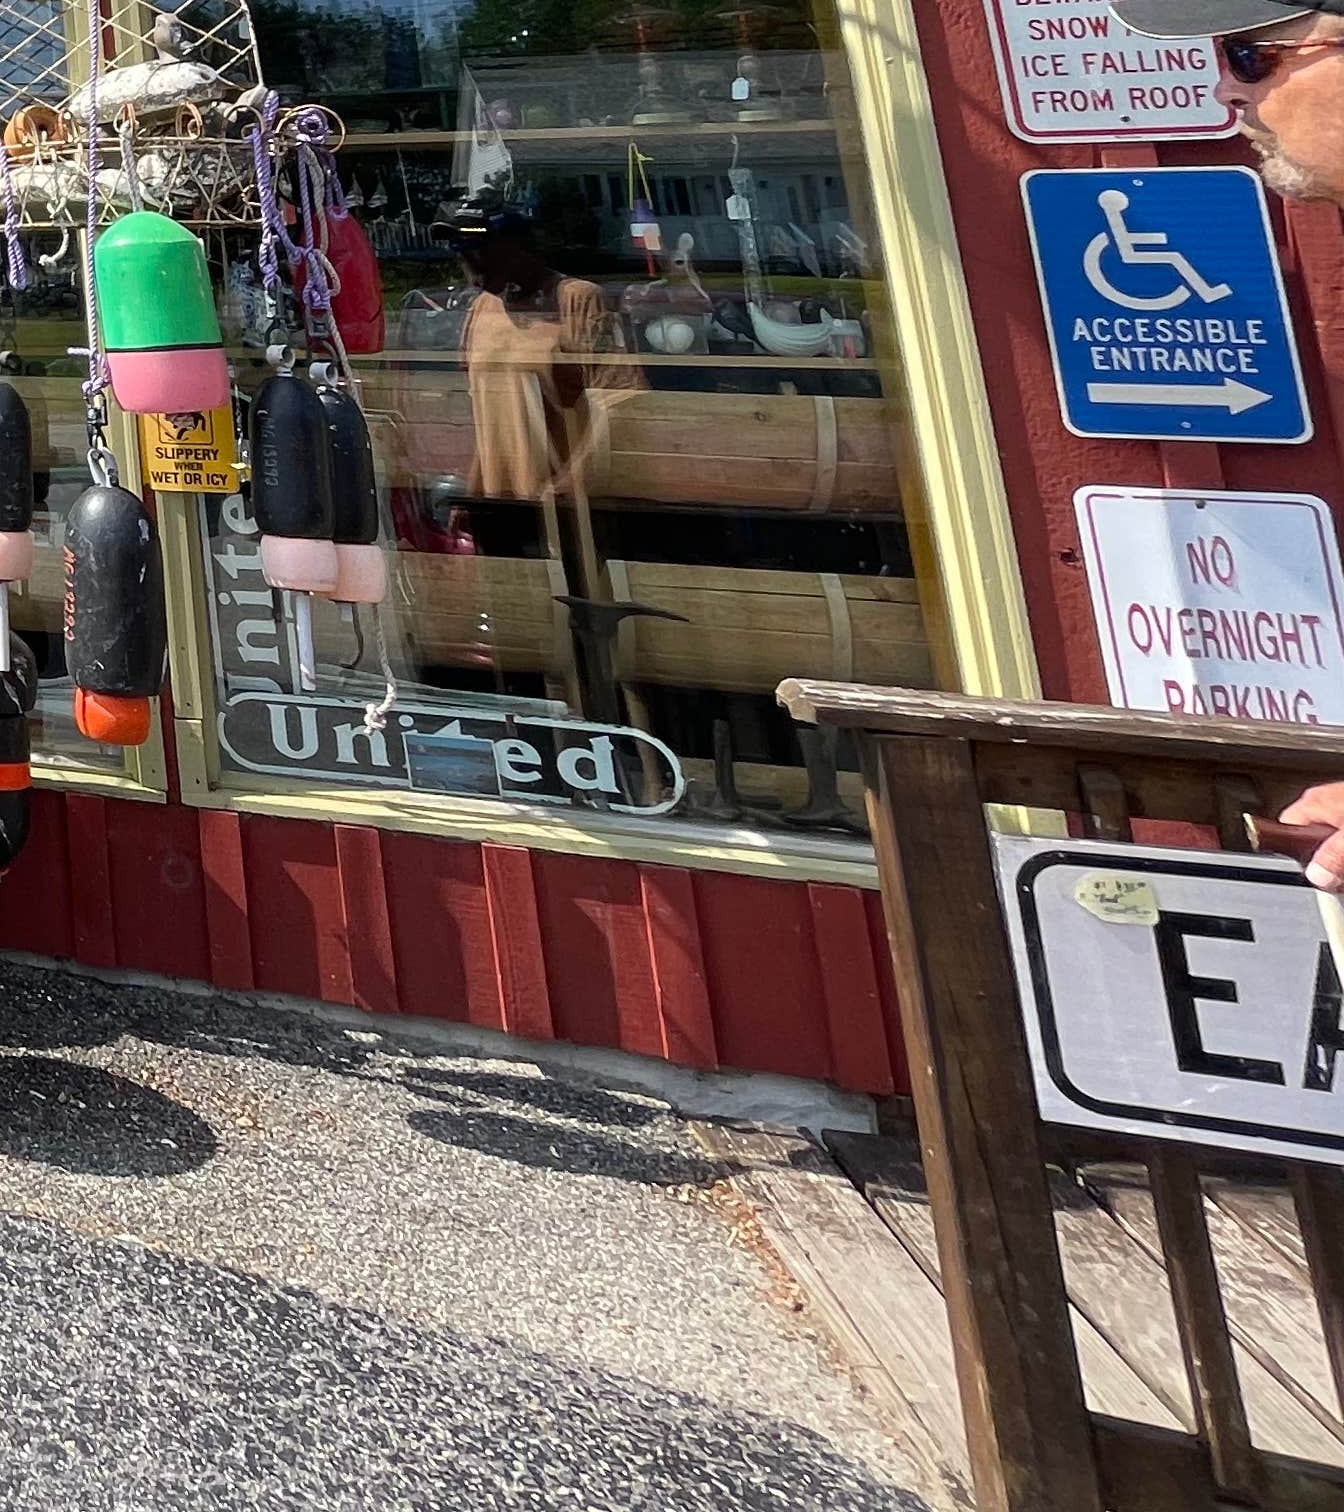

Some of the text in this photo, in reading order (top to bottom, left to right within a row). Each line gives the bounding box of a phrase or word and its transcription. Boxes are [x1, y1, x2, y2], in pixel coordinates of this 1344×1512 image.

[1027, 16, 1109, 41] SNOW
[1021, 47, 1207, 78] ICE FALLING
[1032, 84, 1210, 114] FROM ROOF
[1072, 317, 1267, 345] ACCESSIBLE
[1089, 346, 1260, 374] ENTRANCE
[155, 445, 220, 462] SLIPPERY
[174, 461, 204, 472] WHEN
[151, 471, 229, 487] WET OR ICY
[1186, 535, 1236, 588] NO
[1127, 602, 1324, 667] OVERNIGHT
[1163, 678, 1320, 725] PARKING
[265, 703, 621, 795] Uned
